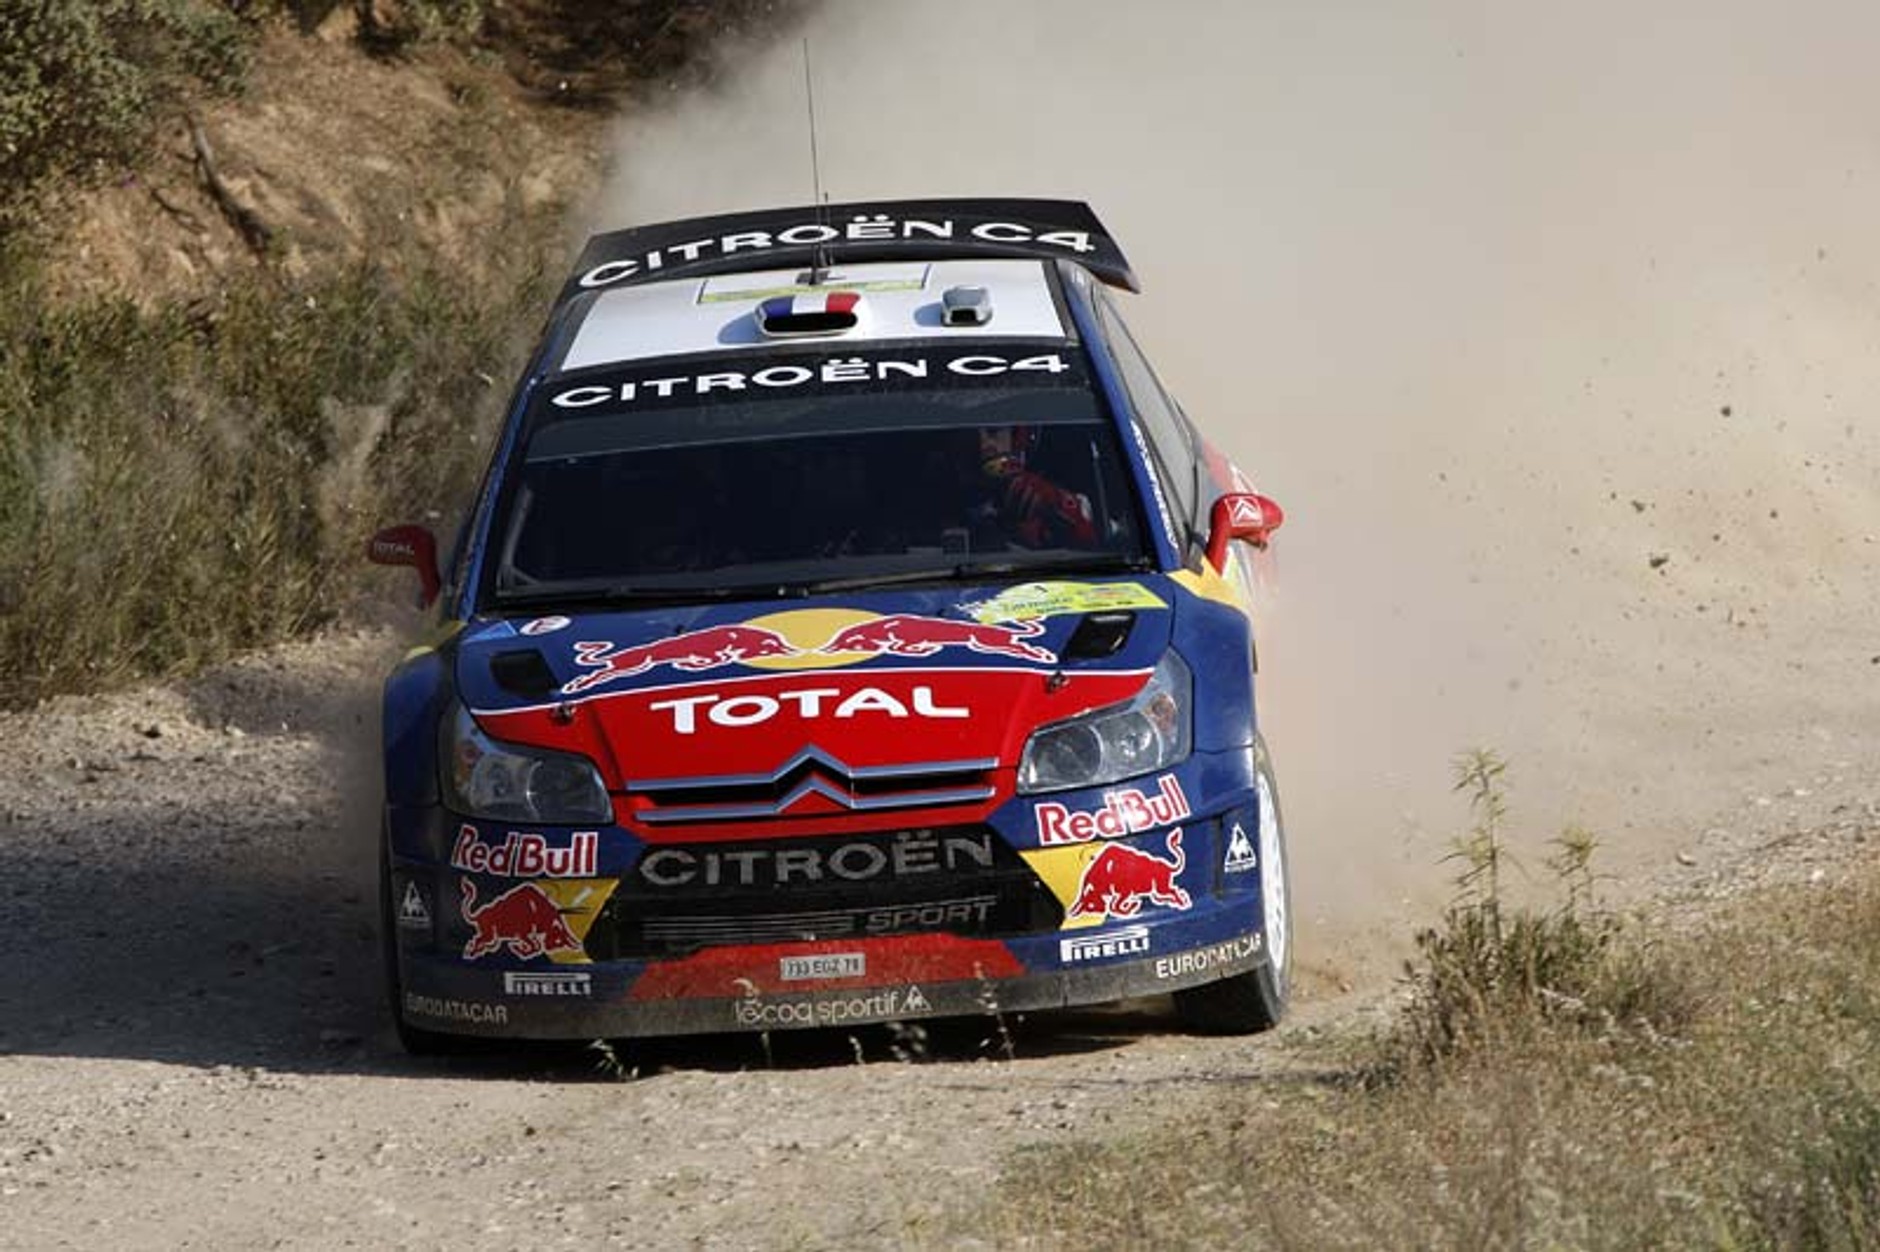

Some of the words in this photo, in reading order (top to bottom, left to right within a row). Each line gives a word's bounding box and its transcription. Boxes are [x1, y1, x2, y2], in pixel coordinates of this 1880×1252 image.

[579, 215, 953, 288] CITROËN
[971, 222, 1096, 253] C4
[552, 357, 927, 407] CITROËN
[947, 354, 1070, 375] C4
[650, 687, 969, 734] TOTAL
[639, 830, 994, 885] CITROËN
[865, 900, 997, 932] SPORT
[1060, 926, 1149, 962] PIRELLI
[504, 972, 592, 995] PIRELLI
[817, 991, 899, 1024] sportif
